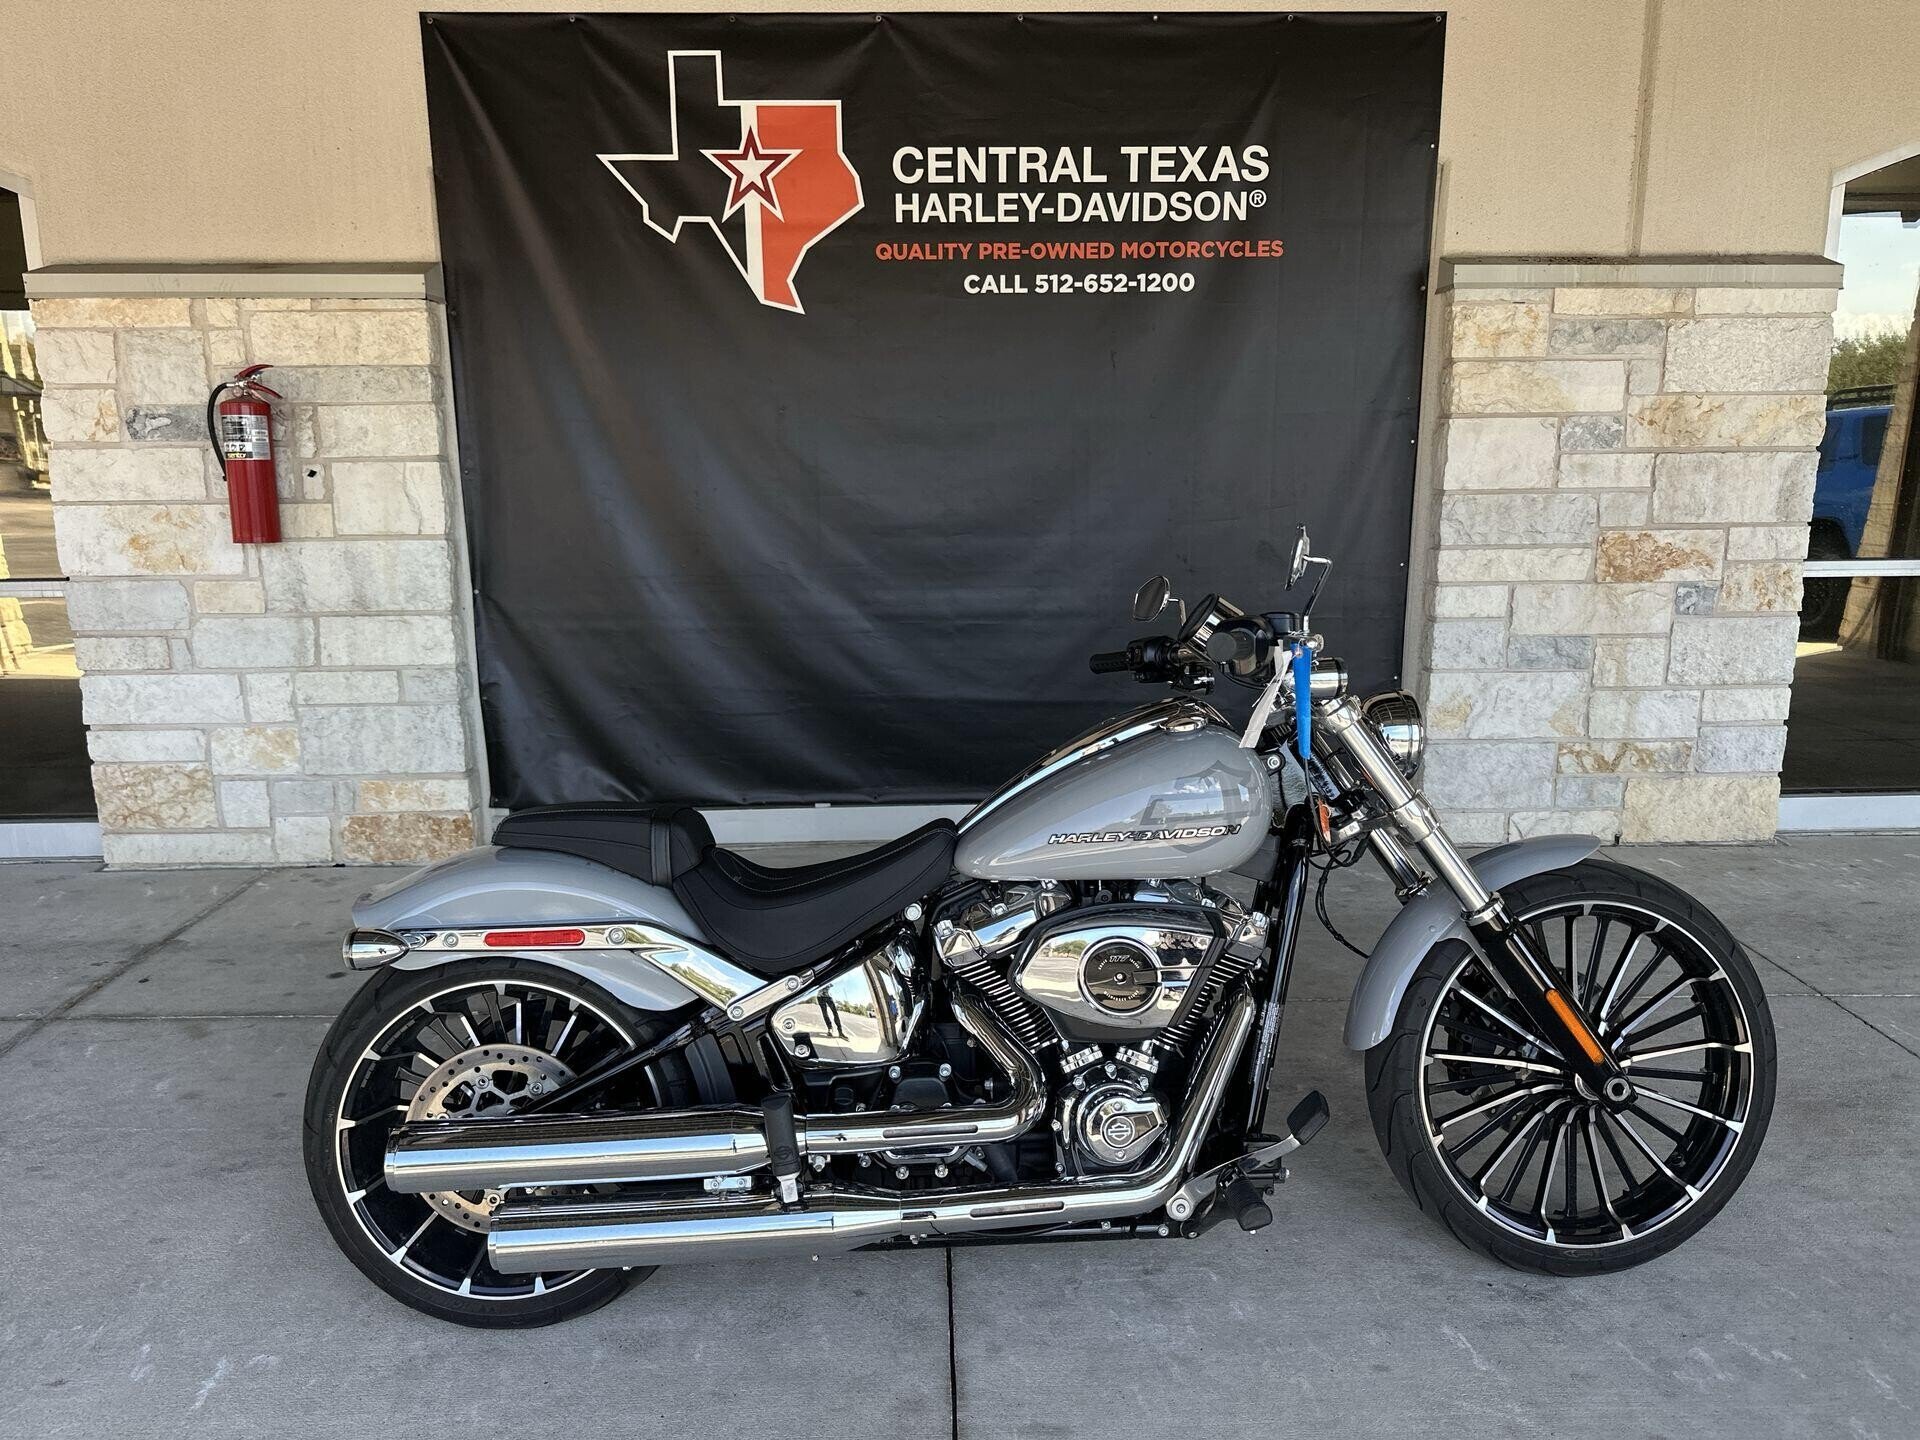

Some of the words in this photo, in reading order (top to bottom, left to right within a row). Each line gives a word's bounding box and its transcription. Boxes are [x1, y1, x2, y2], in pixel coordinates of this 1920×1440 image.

[892, 146, 1108, 184] CENTRAL
[1120, 145, 1270, 183] TEXAS
[875, 242, 973, 261] QUALITY
[978, 242, 1115, 260] PRE-OWNED
[1121, 239, 1284, 259] MOTORCYCLES
[963, 274, 1029, 294] CALL
[1034, 272, 1196, 294] 512-652-1200
[1048, 824, 1242, 845] HARLEY-DAVIDSON
